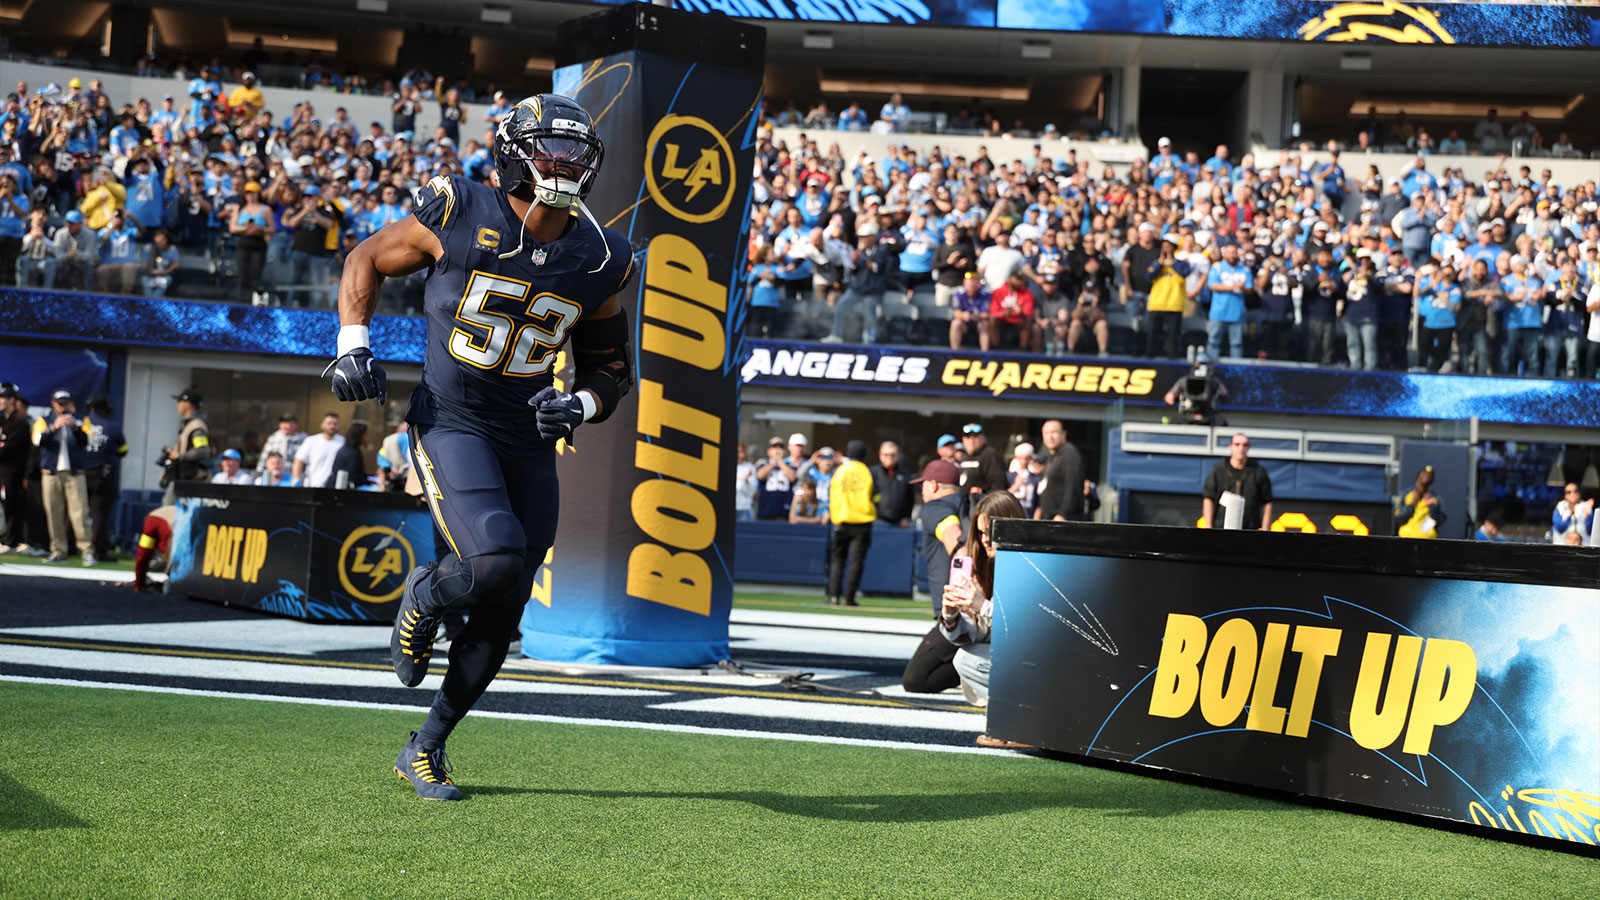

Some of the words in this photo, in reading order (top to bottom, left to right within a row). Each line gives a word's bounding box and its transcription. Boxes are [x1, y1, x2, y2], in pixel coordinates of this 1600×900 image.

[661, 143, 722, 203] LA
[476, 227, 501, 248] C
[448, 270, 583, 378] 52
[640, 233, 729, 371] UP
[741, 348, 930, 384] ANGELES
[942, 359, 1158, 396] CHARGERS
[626, 378, 722, 617] BOLT
[202, 524, 245, 581] BOLT
[240, 528, 268, 584] UP
[351, 547, 403, 589] LA
[1148, 613, 1343, 739] BOLT
[1349, 631, 1478, 757] UP
